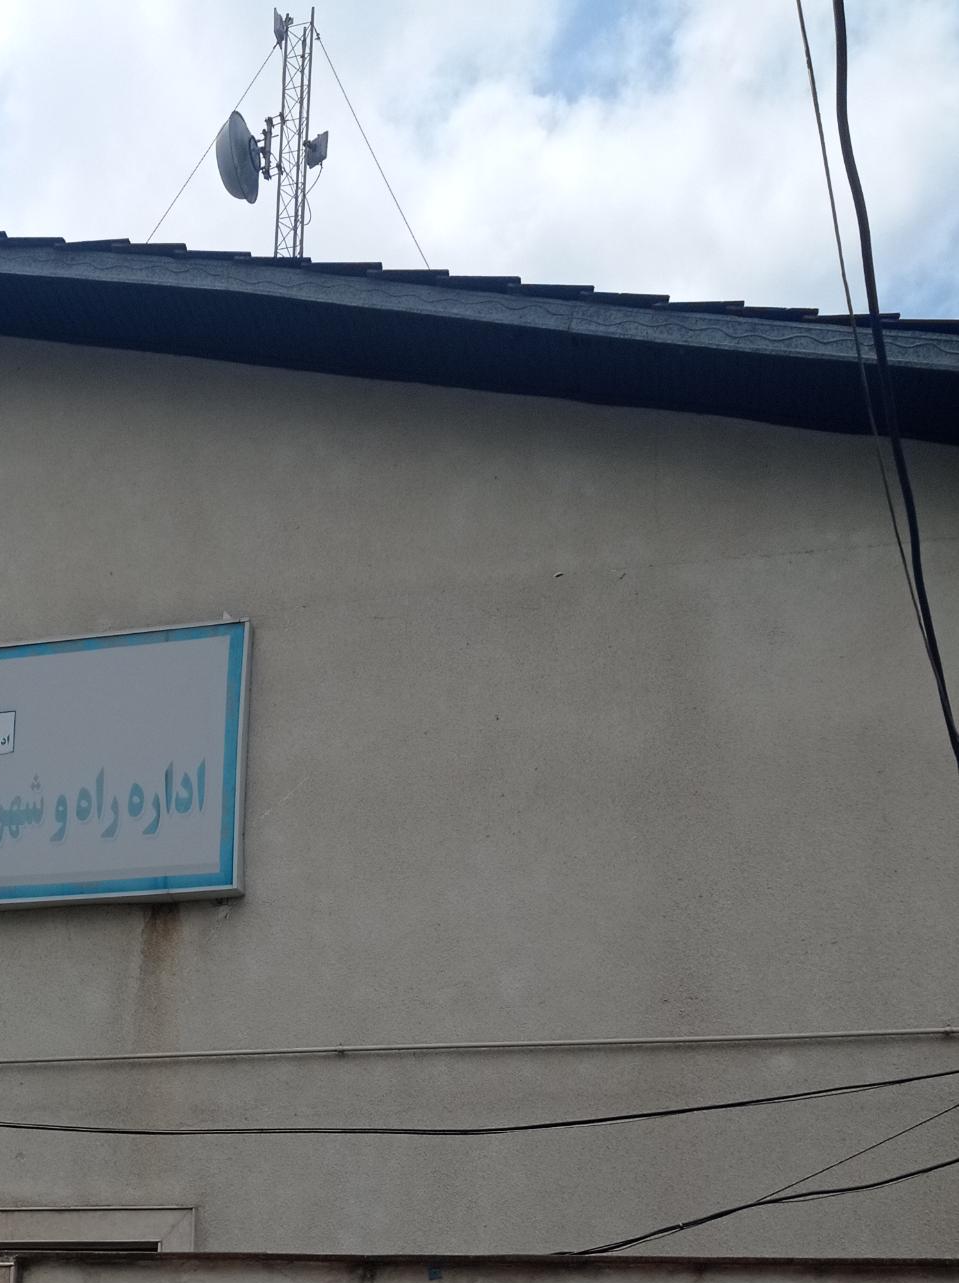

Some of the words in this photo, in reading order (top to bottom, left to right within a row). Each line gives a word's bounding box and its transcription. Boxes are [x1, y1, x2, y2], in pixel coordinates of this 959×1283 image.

[49, 794, 68, 843] و
[75, 766, 120, 839] راه
[127, 757, 206, 836] اداره
